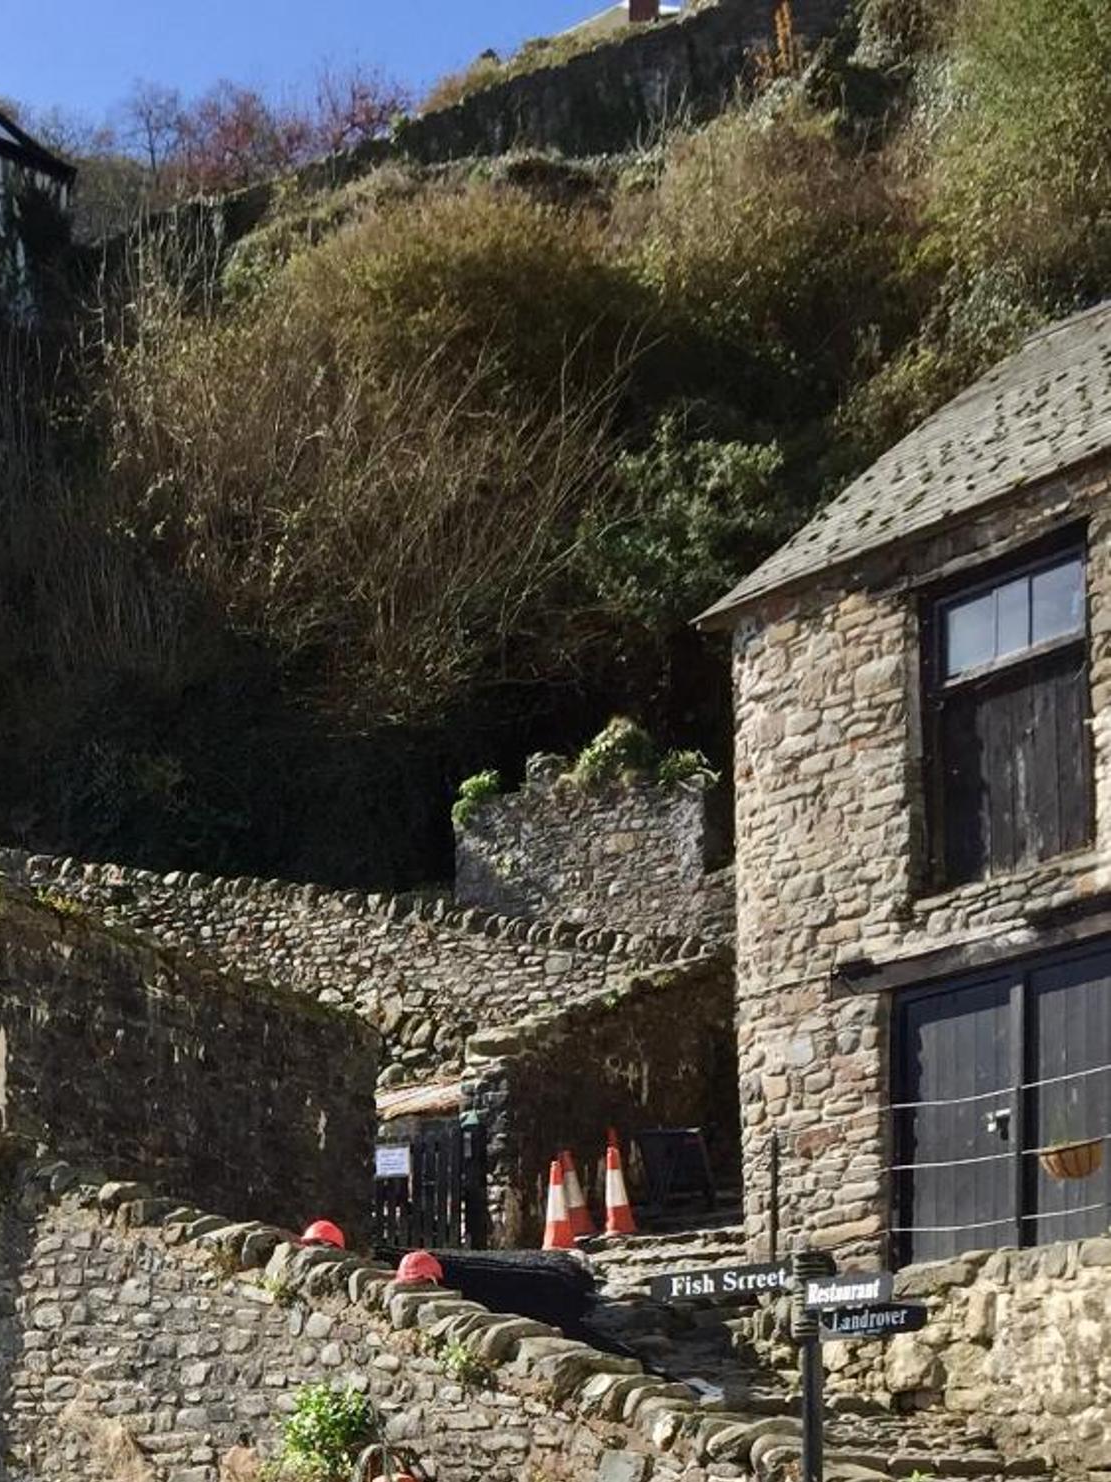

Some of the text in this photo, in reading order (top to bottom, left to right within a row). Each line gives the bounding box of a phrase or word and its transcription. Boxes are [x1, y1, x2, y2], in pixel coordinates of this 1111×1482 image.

[670, 1267, 787, 1297] Fish Street
[806, 1278, 880, 1304] Restaurant
[831, 1309, 908, 1332] Landrover
